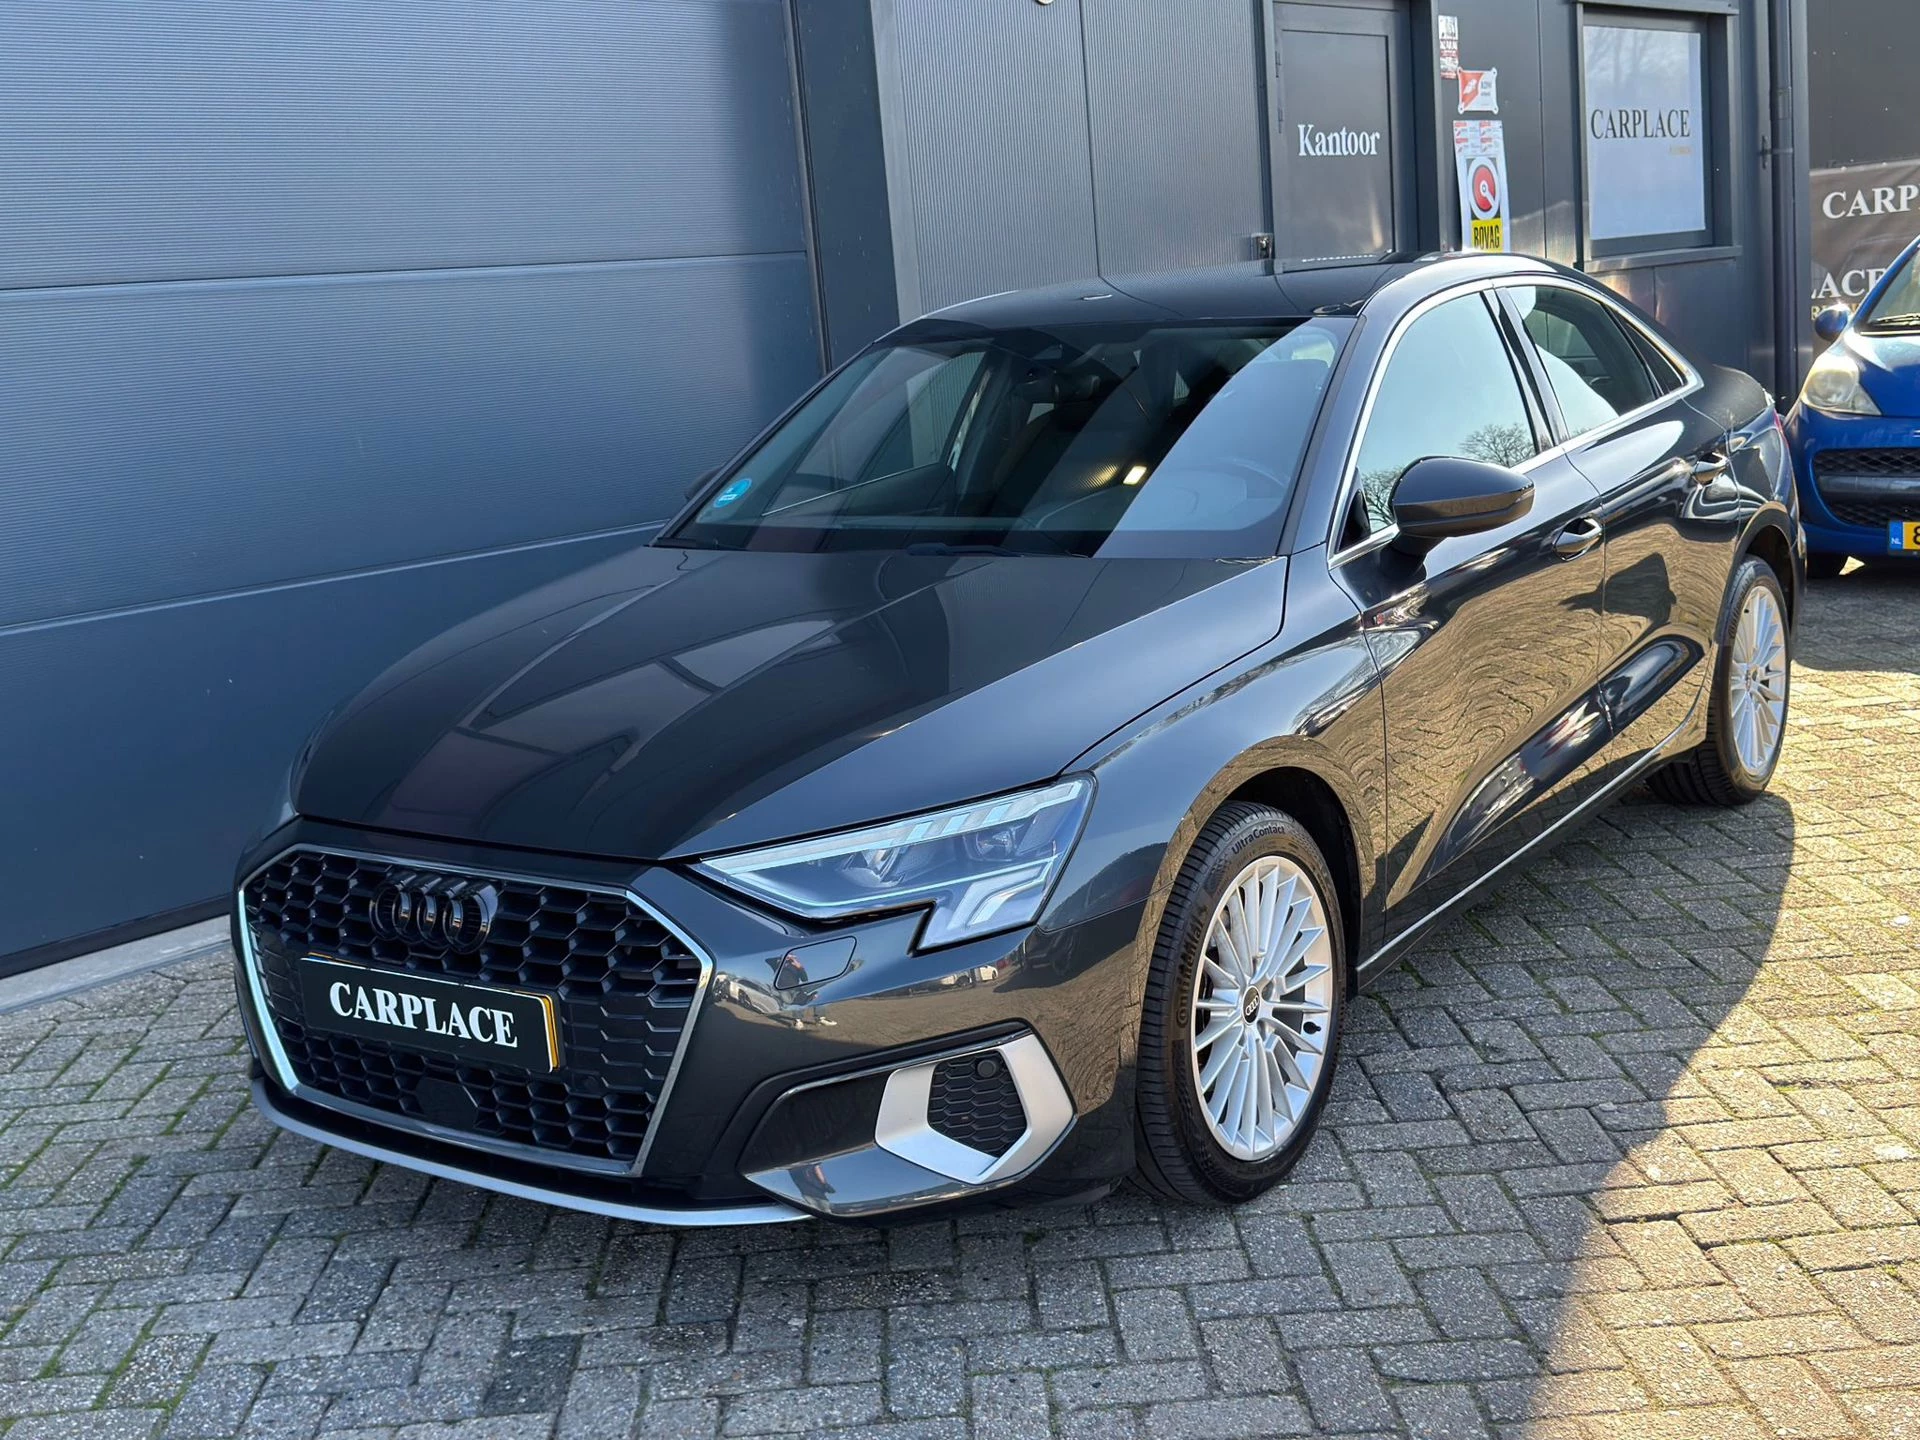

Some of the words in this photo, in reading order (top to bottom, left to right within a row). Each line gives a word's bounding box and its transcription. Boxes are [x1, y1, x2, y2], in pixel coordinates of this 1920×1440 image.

[1297, 124, 1380, 156] Kantoor
[1591, 108, 1690, 140] CARPLACE
[1822, 184, 1920, 220] CARP
[1473, 225, 1500, 250] BOVAG
[1231, 825, 1285, 855] UltraContact
[329, 981, 518, 1048] CARPLACE
